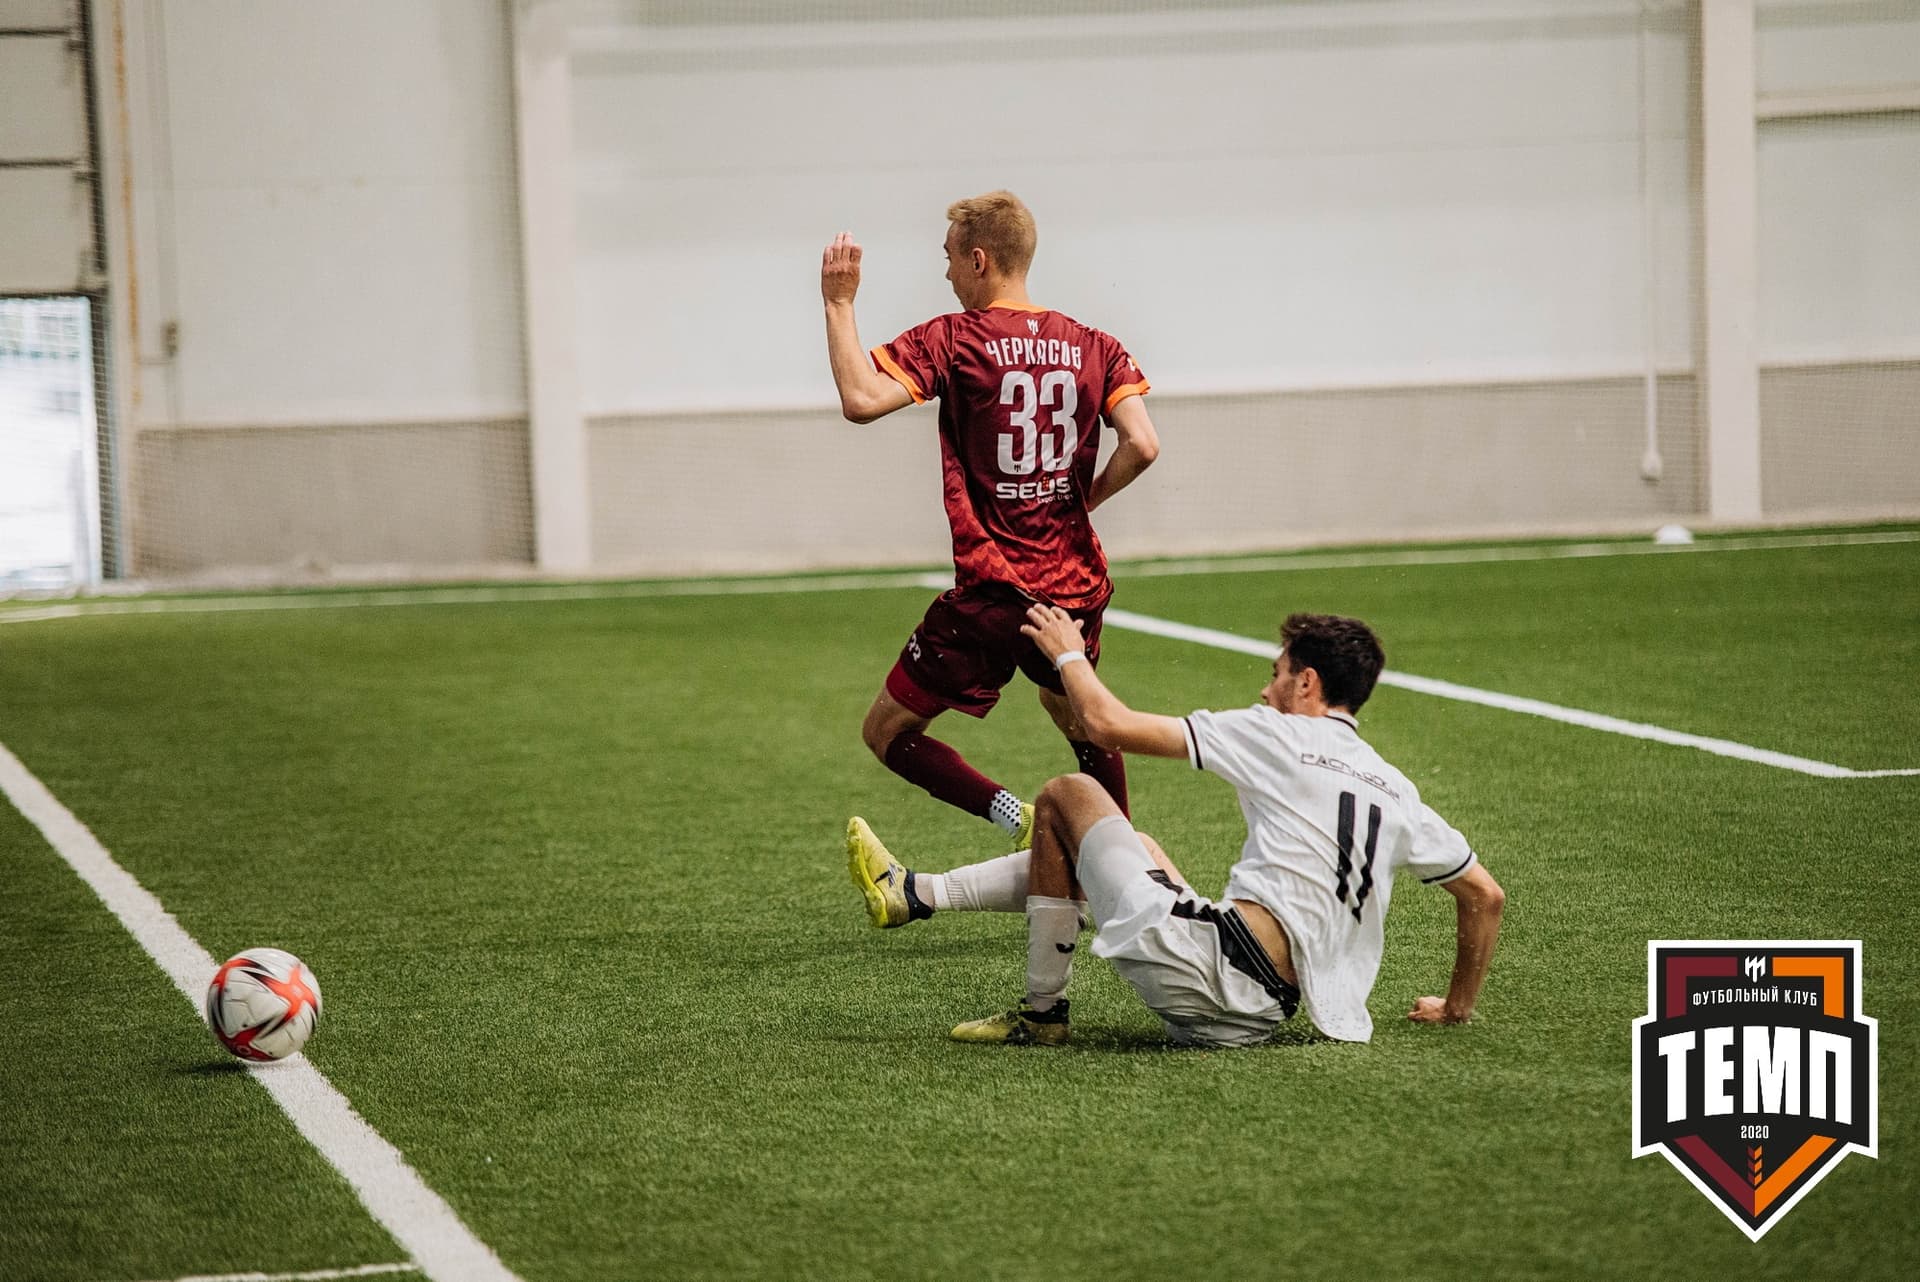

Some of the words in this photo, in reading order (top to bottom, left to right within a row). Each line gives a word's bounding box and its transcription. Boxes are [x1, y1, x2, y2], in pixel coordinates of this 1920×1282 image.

[985, 336, 1082, 370] ЧЕРКАСОВ
[997, 370, 1078, 475] 33
[996, 477, 1071, 499] SEUS
[1335, 790, 1382, 925] 11
